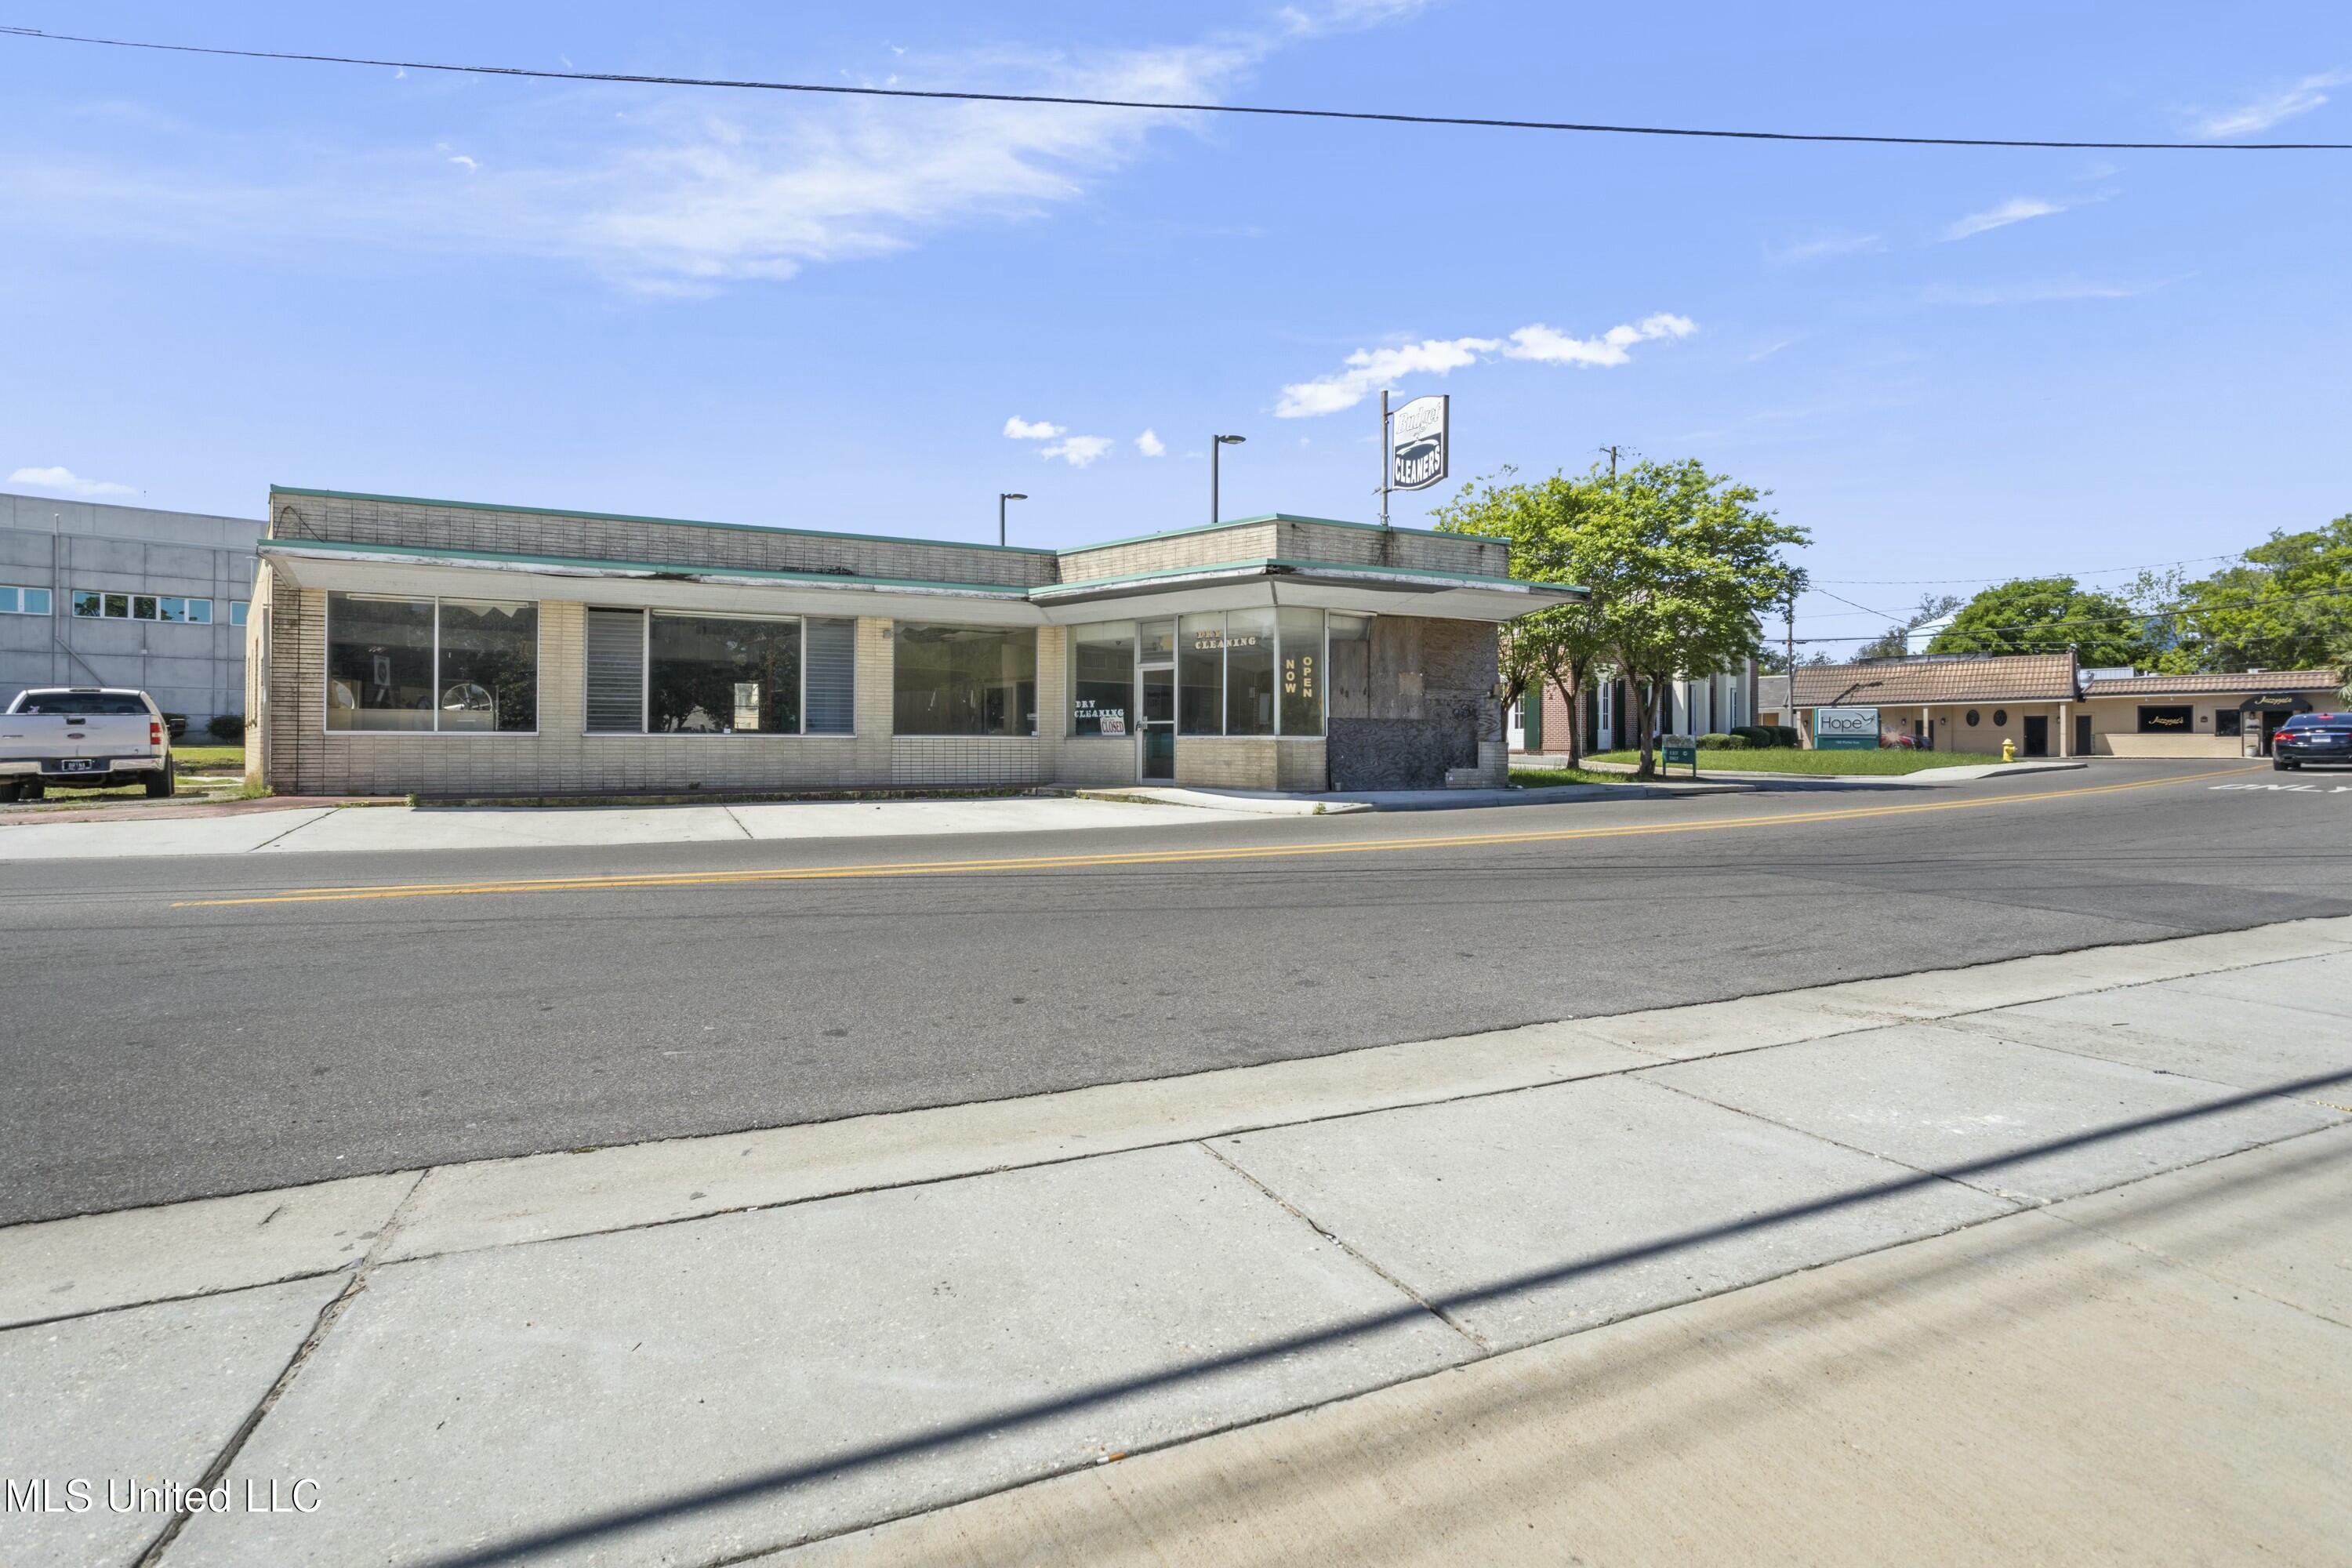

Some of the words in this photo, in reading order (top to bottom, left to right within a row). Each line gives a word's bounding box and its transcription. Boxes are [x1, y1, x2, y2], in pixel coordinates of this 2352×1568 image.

[1396, 445, 1440, 484] CLEANERS
[1196, 630, 1221, 639] DRY
[1195, 637, 1256, 649] CLEANING
[1285, 659, 1297, 693] NOW
[1303, 656, 1312, 698] OPEN
[1074, 709, 1124, 718] CLEANING
[1102, 720, 1124, 733] CLOSED
[1821, 717, 1862, 733] Hope
